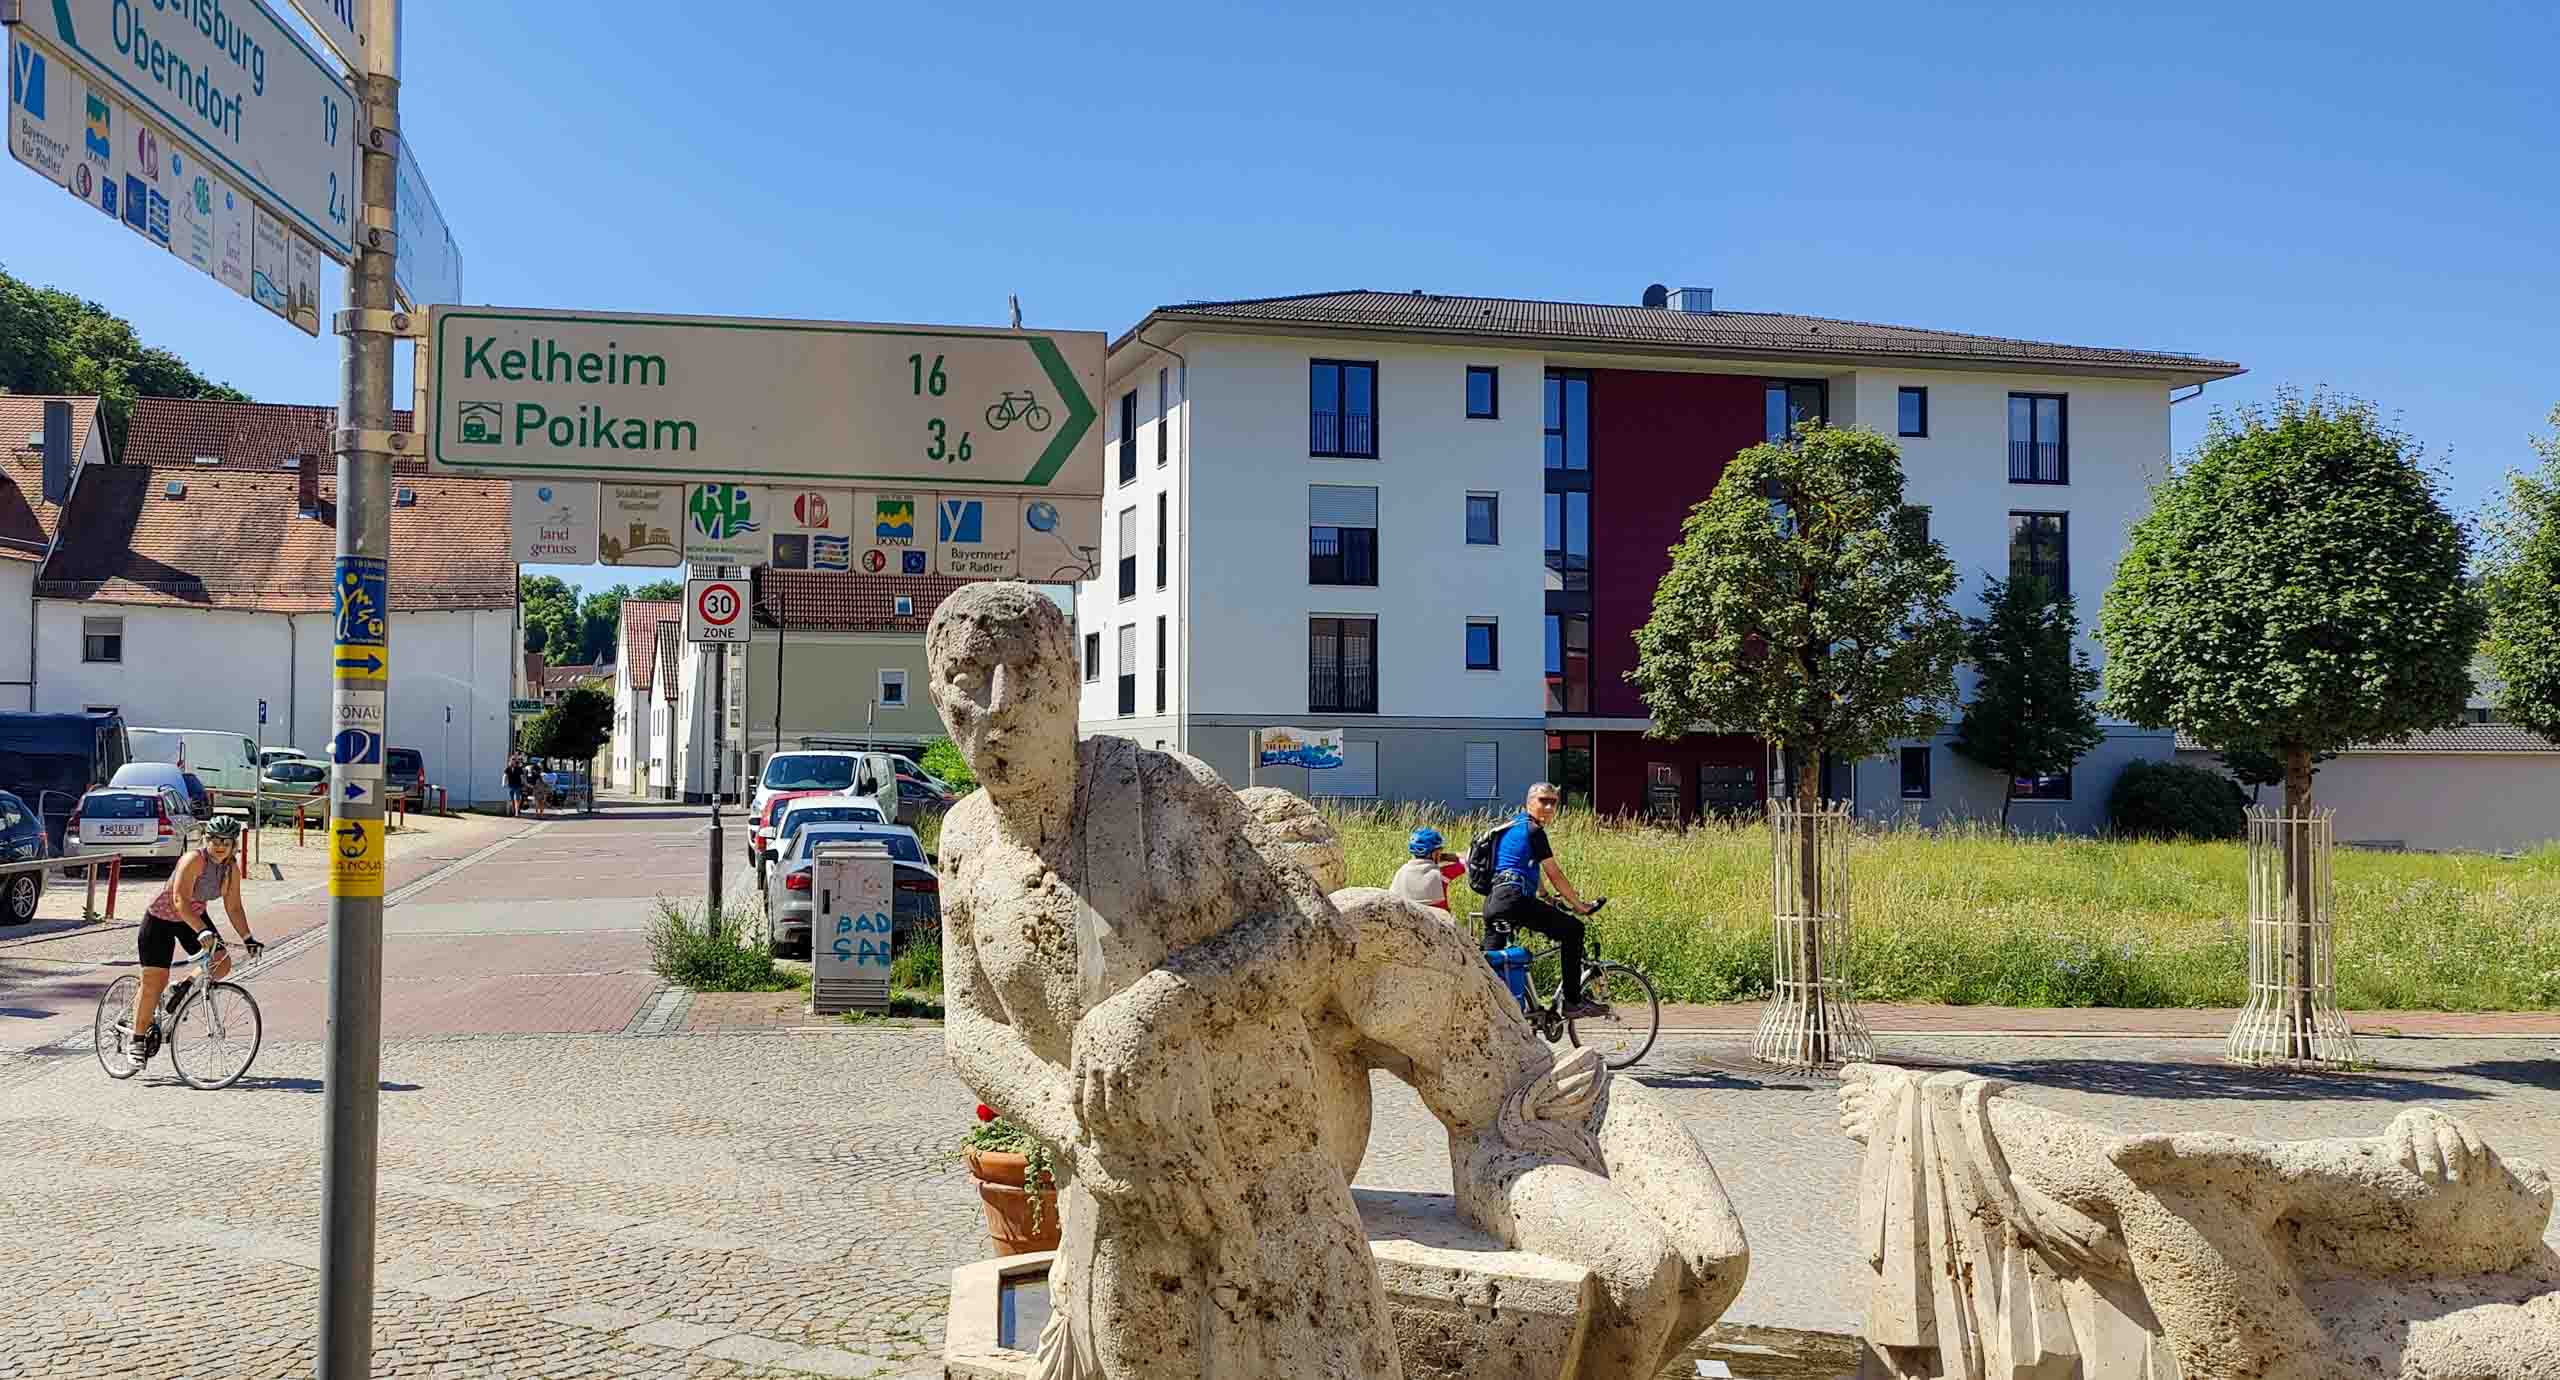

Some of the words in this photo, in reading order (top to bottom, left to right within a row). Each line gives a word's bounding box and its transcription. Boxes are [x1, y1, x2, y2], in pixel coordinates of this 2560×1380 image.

[112, 0, 242, 144] Oberndorf
[321, 95, 338, 146] 19
[463, 336, 666, 386] Kelheim
[909, 353, 947, 397] 16
[515, 403, 697, 451] Poikam
[927, 418, 972, 464] 3,6
[530, 543, 576, 556] genuss
[540, 527, 569, 541] land
[707, 595, 732, 615] 30
[703, 628, 736, 639] ZONE
